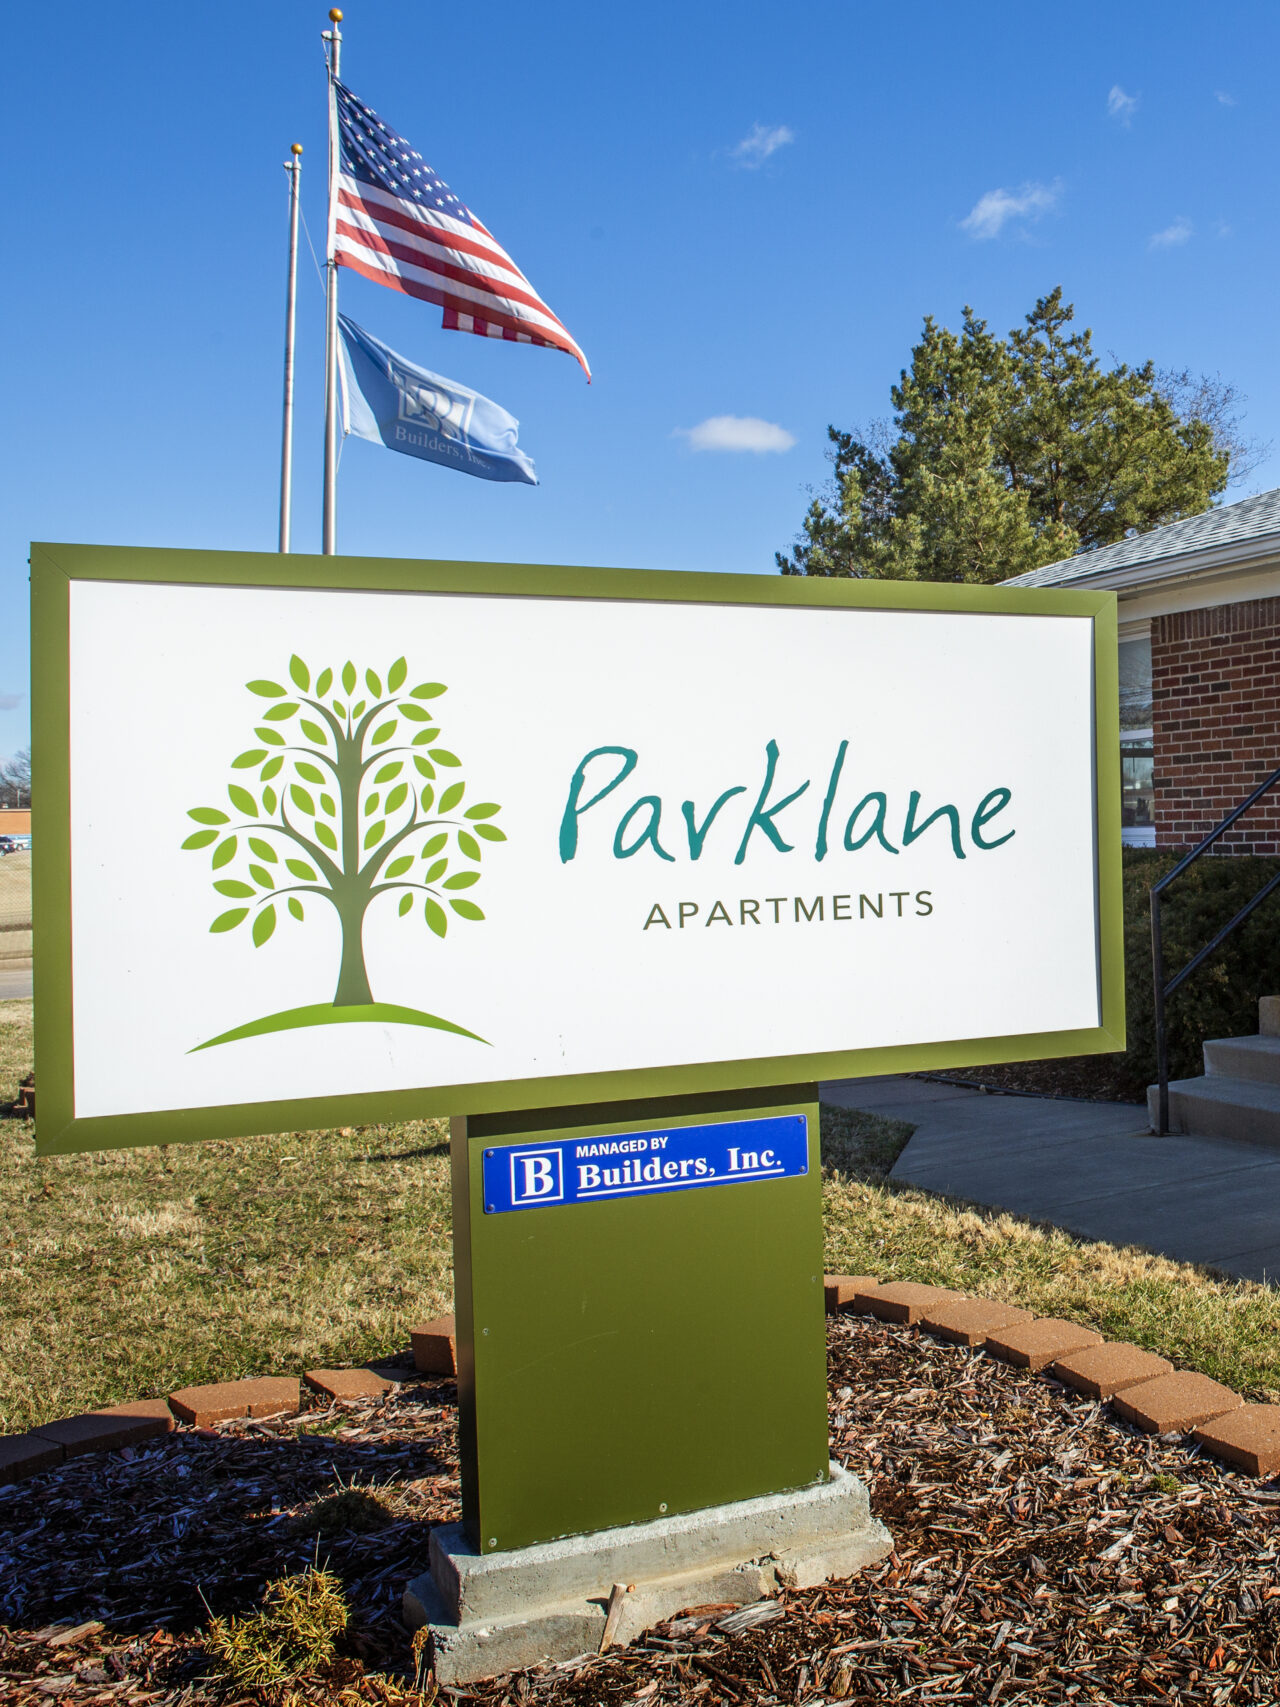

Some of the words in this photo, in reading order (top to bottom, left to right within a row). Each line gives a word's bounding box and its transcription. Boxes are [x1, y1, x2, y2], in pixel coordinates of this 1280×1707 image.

[395, 425, 464, 459] Builders,
[559, 738, 1016, 865] Parklane
[642, 890, 935, 931] APARTMENTS
[575, 1139, 648, 1158] MANAGED
[650, 1136, 669, 1150] BY
[520, 1157, 554, 1197] B
[577, 1155, 715, 1190] Builders,
[727, 1147, 782, 1172] Inc.
